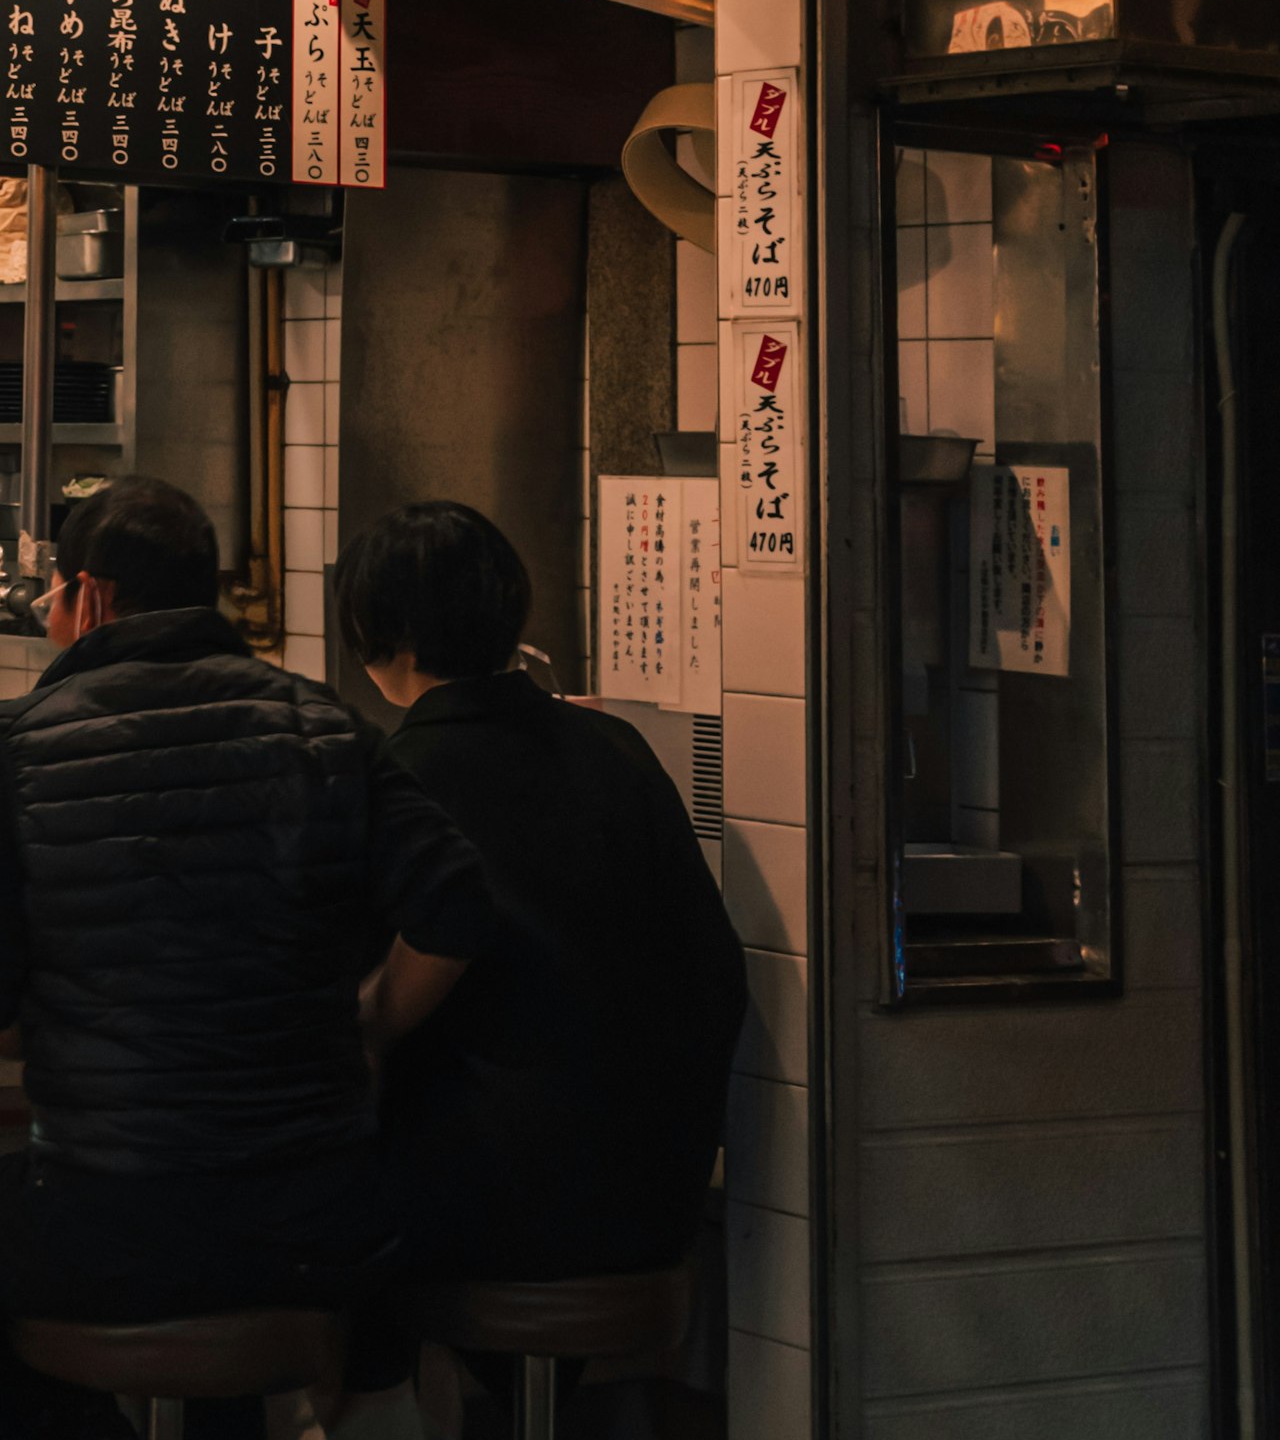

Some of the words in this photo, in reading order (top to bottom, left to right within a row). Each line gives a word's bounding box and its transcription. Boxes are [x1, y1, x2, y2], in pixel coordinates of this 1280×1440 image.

[350, 11, 377, 73] 天玉
[6, 42, 22, 100] うどん
[21, 45, 37, 100] そば
[57, 47, 72, 104] うどん
[72, 49, 87, 105] そば
[107, 52, 122, 108] うどん
[122, 54, 137, 109] そば
[157, 56, 172, 113] うどん
[172, 58, 187, 113] そば
[206, 61, 221, 117] うどん
[220, 64, 235, 118] そば
[255, 65, 269, 121] うどん
[268, 67, 284, 121] そば
[303, 70, 317, 125] うどん
[316, 71, 330, 125] そば
[350, 74, 364, 129] うどん
[363, 76, 377, 129] そば
[752, 87, 785, 132] ダブル
[10, 106, 29, 158] 三四〇
[61, 110, 80, 162] 三四〇
[112, 114, 130, 166] 三四〇
[161, 118, 180, 170] 三四〇
[210, 124, 229, 173] 二八〇
[259, 126, 277, 176] 三三〇
[307, 131, 324, 181] 三八〇
[354, 136, 371, 184] 四三〇
[744, 276, 790, 299] 470円
[754, 339, 787, 386] ダブル
[749, 531, 795, 556] 470円
